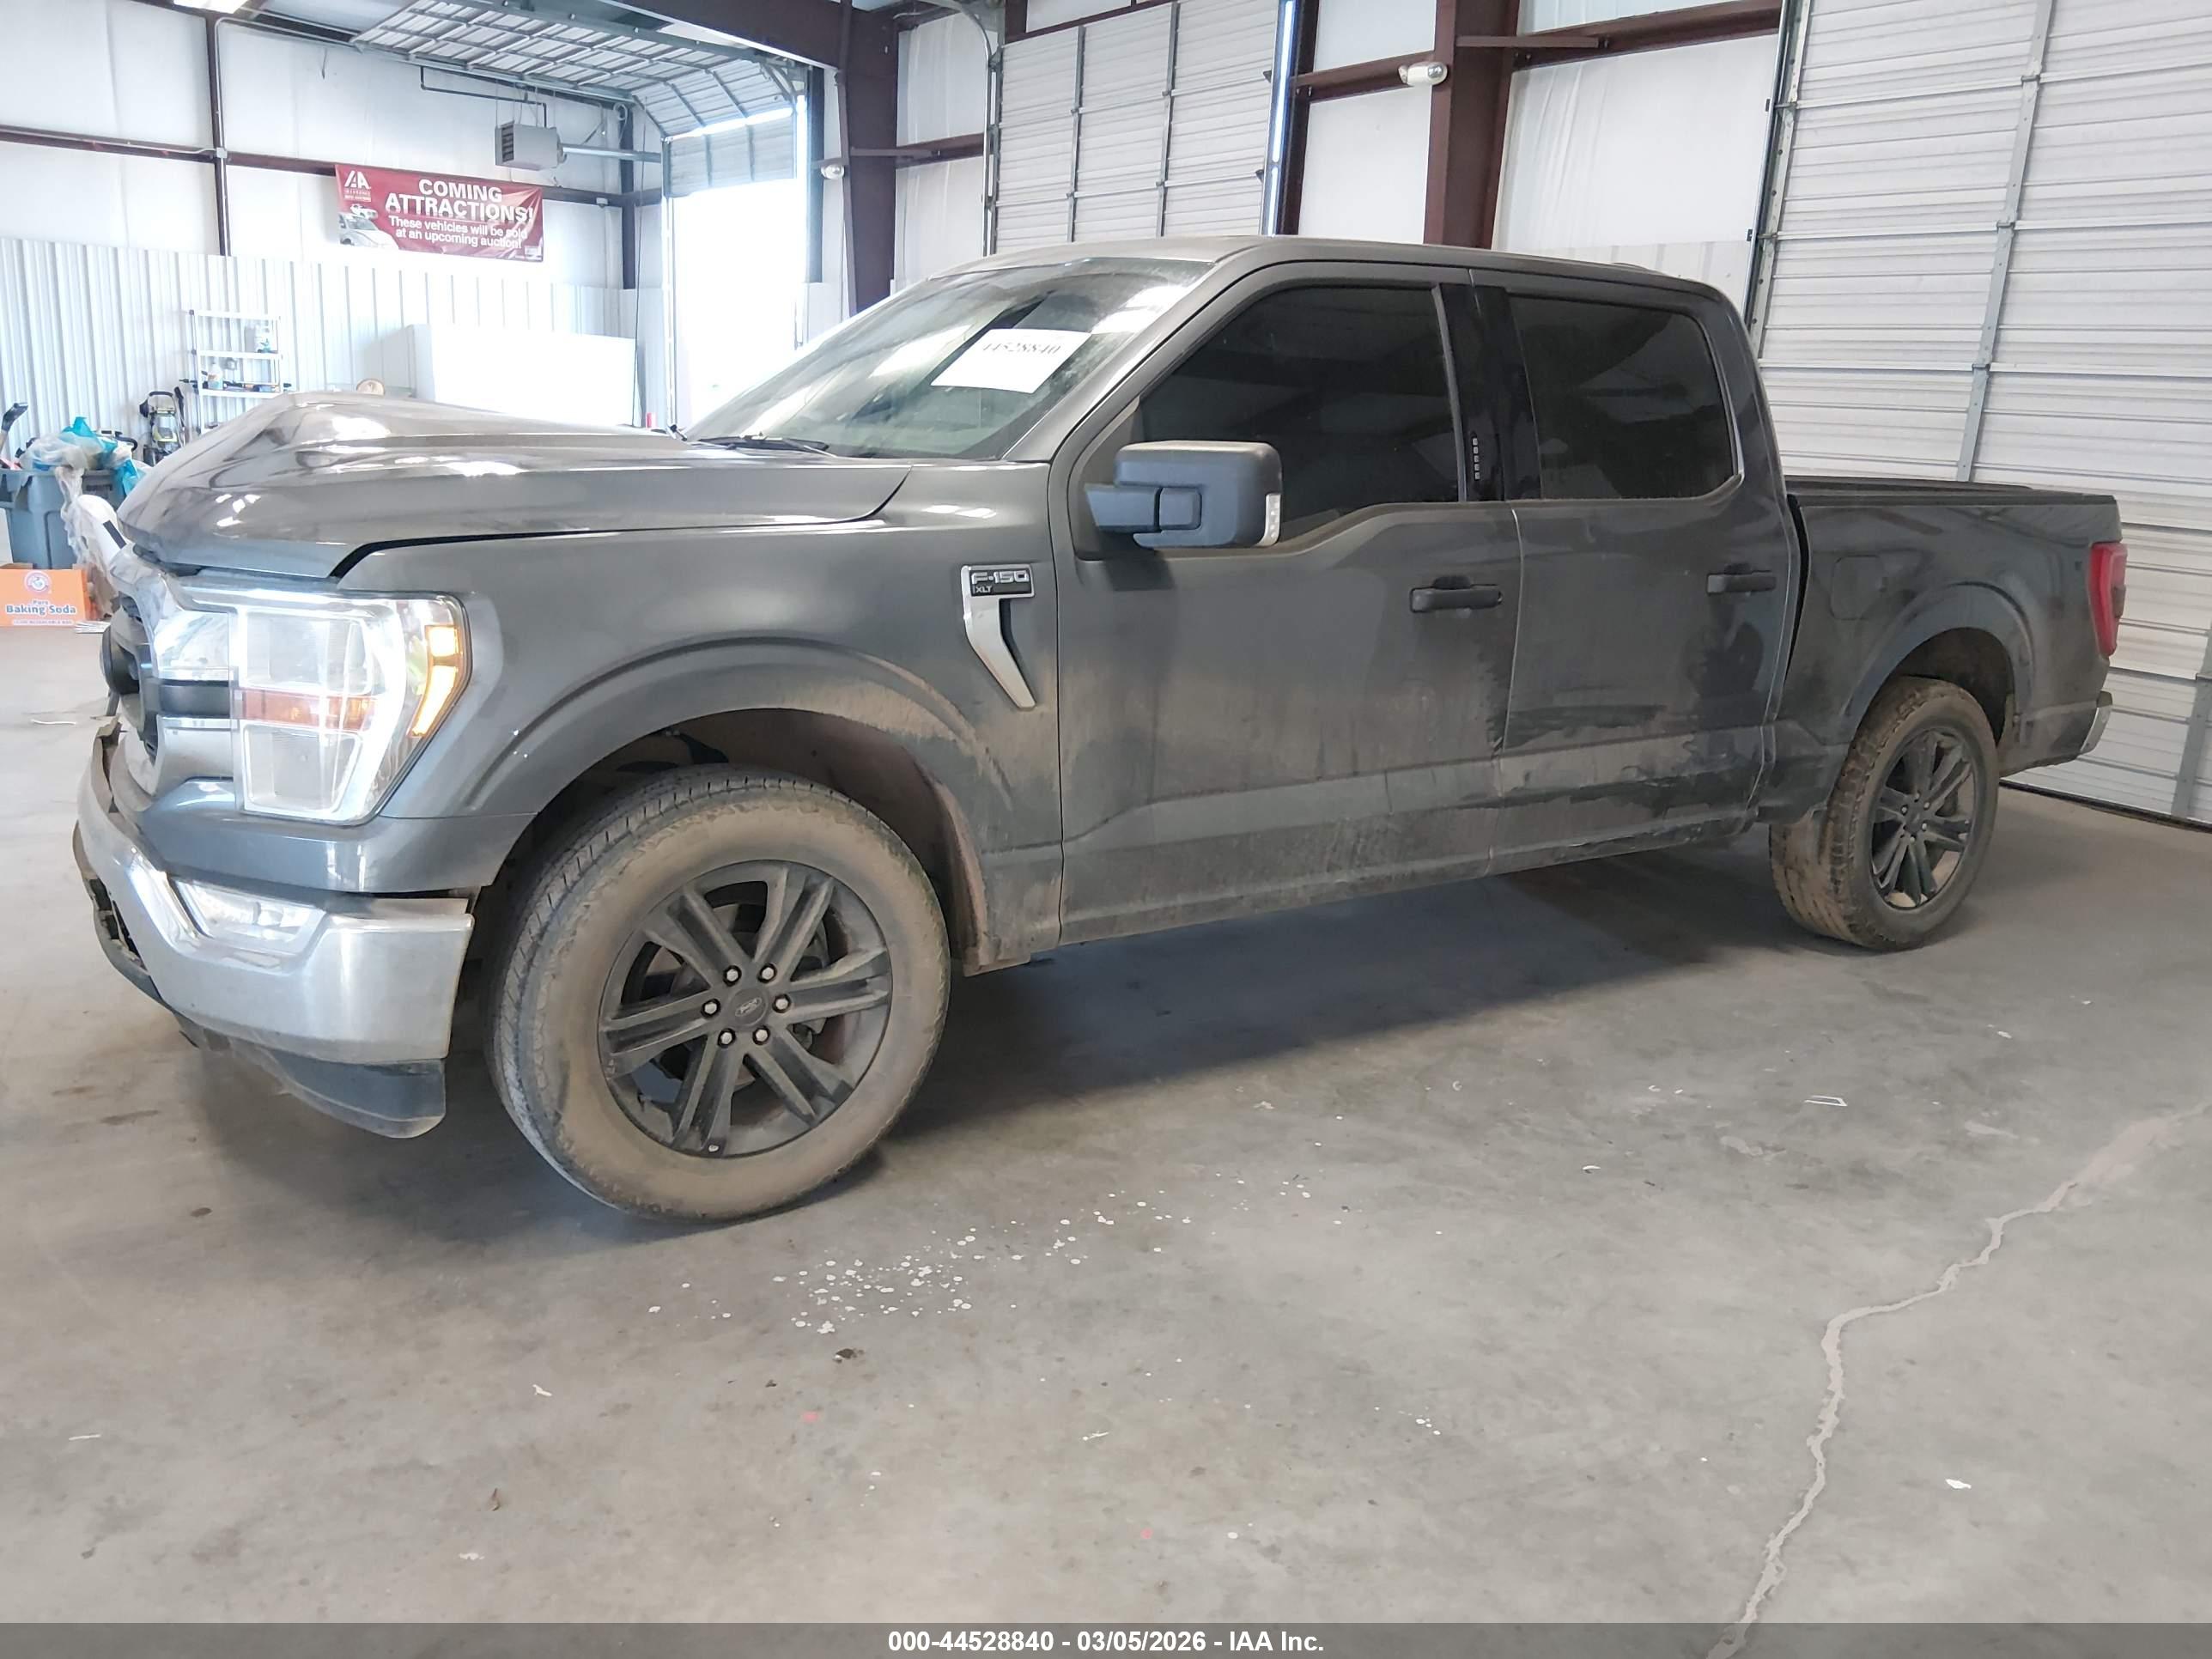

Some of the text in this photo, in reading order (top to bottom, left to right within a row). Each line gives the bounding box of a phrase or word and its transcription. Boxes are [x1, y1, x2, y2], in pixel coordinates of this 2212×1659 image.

[419, 179, 502, 203] COMING
[386, 192, 533, 223] ATTRACTIONS!
[388, 215, 527, 240] These vehicles will be sold
[396, 227, 407, 238] at
[409, 230, 422, 240] an
[425, 231, 478, 247] upcoming
[975, 585, 993, 593] XLT
[7, 605, 76, 615] Baking Soda
